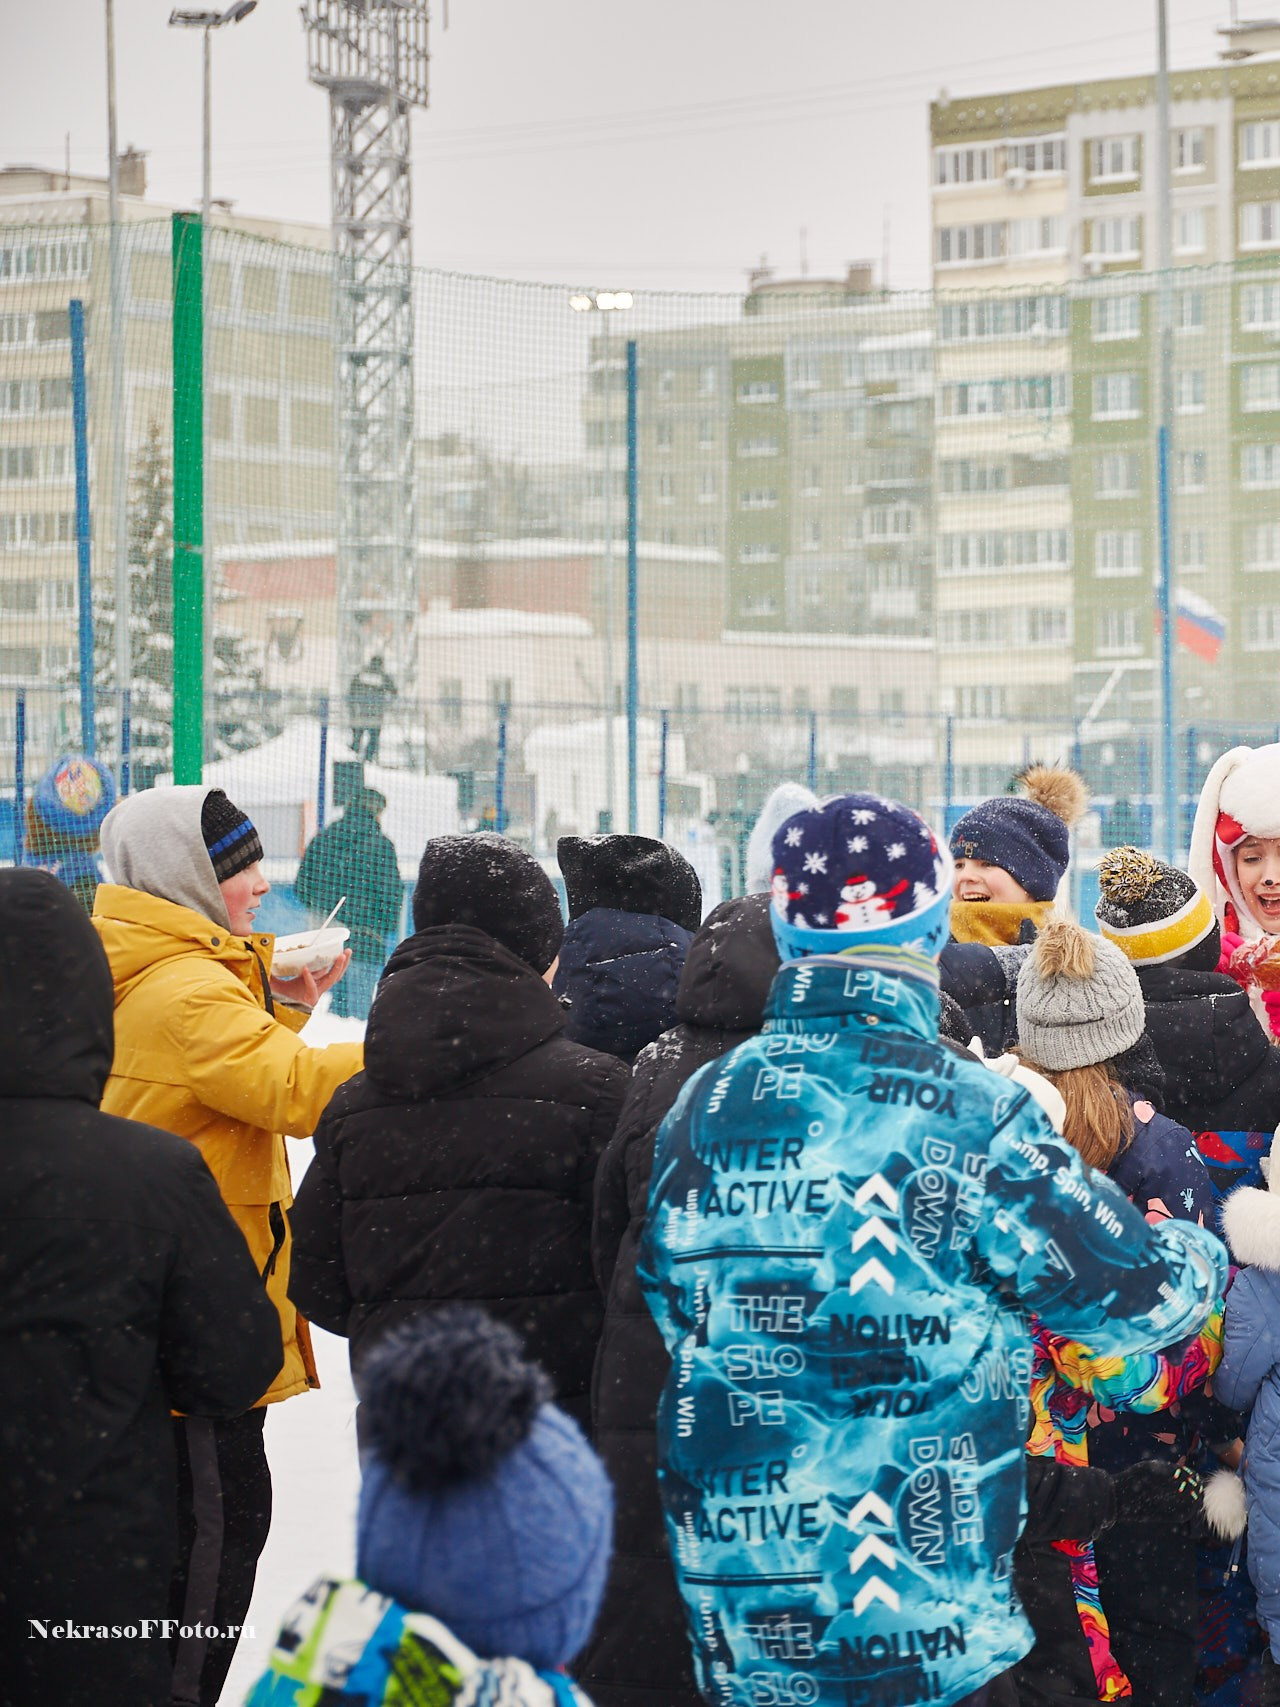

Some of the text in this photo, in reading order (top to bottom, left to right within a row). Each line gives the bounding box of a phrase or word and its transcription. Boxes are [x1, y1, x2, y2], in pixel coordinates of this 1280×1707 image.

[843, 969, 901, 1006] PE
[707, 1075, 733, 1114] Win
[752, 1064, 804, 1101] PE
[867, 1072, 957, 1120] YOUR
[704, 1178, 829, 1219] ACTIVE
[911, 1137, 956, 1259] DOWN
[1002, 1132, 1124, 1239] Jump, Spin, Win
[726, 1295, 806, 1333] THE
[829, 1312, 951, 1348] NATION
[723, 1344, 806, 1381] SLO
[677, 1396, 697, 1438] Win
[727, 1390, 786, 1426] PE
[908, 1436, 945, 1567] DOWN
[949, 1432, 985, 1546] SLIDE
[699, 1501, 820, 1544] ACTIVE
[739, 1622, 816, 1660] THE
[838, 1620, 967, 1666] NATION
[749, 1670, 820, 1706] SLO
